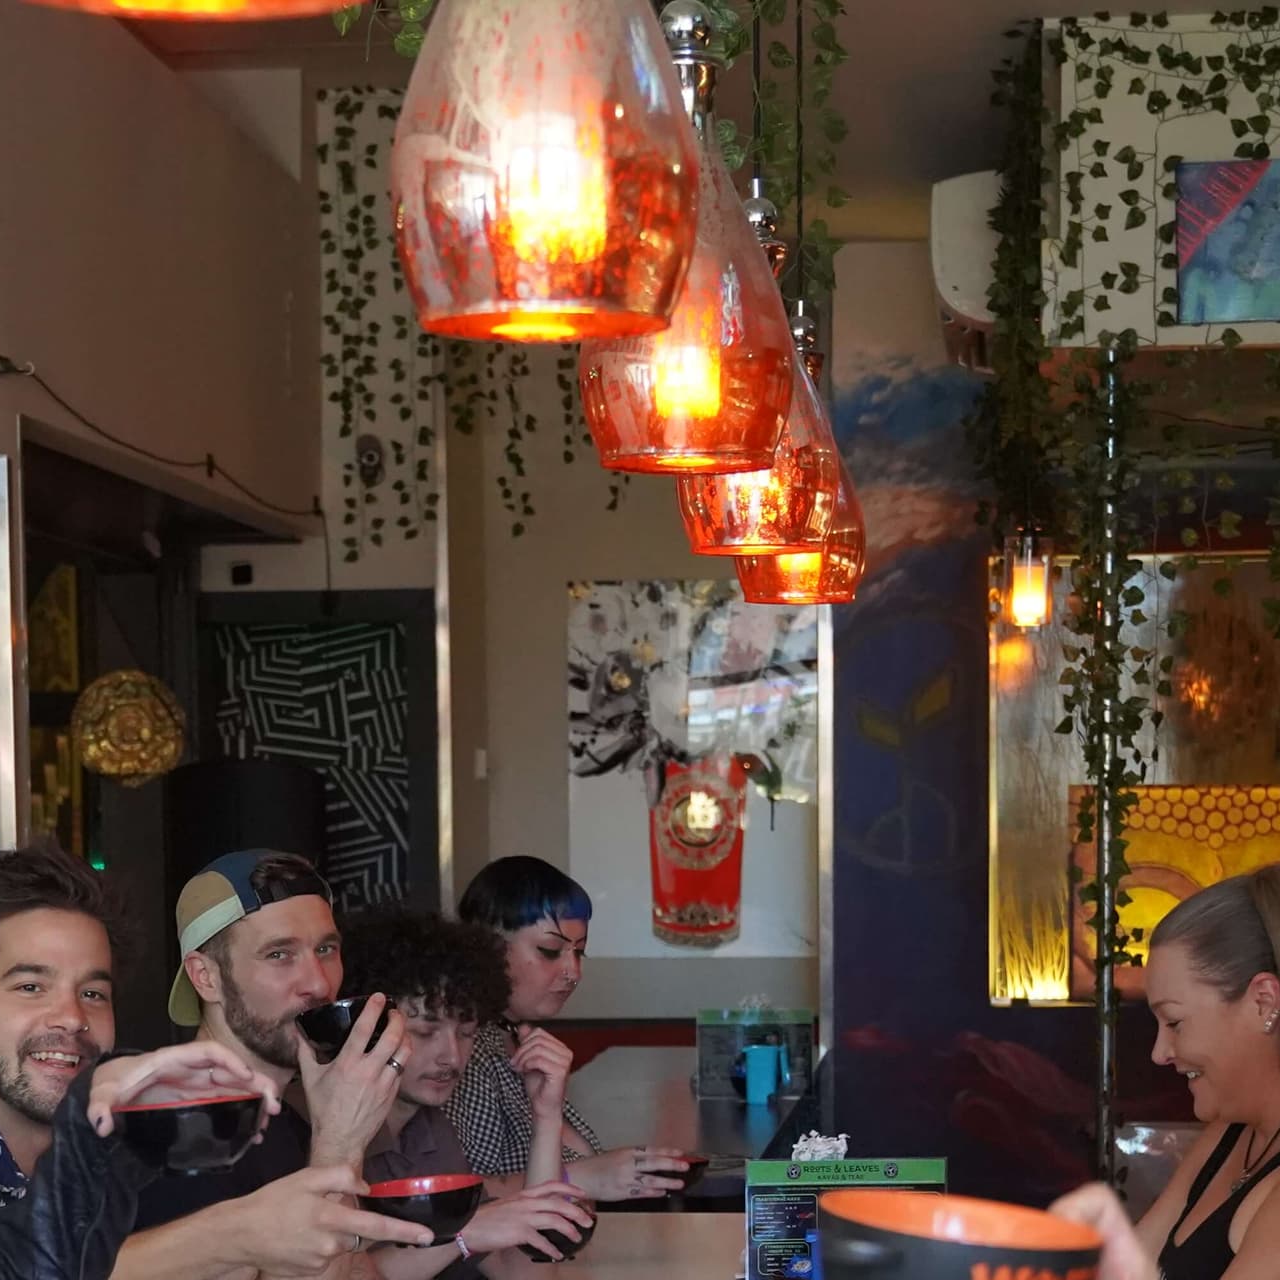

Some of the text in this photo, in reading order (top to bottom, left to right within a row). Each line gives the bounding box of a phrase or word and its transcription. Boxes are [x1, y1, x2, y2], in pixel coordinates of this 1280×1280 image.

[803, 1164, 880, 1174] ROOTS & LEAVES
